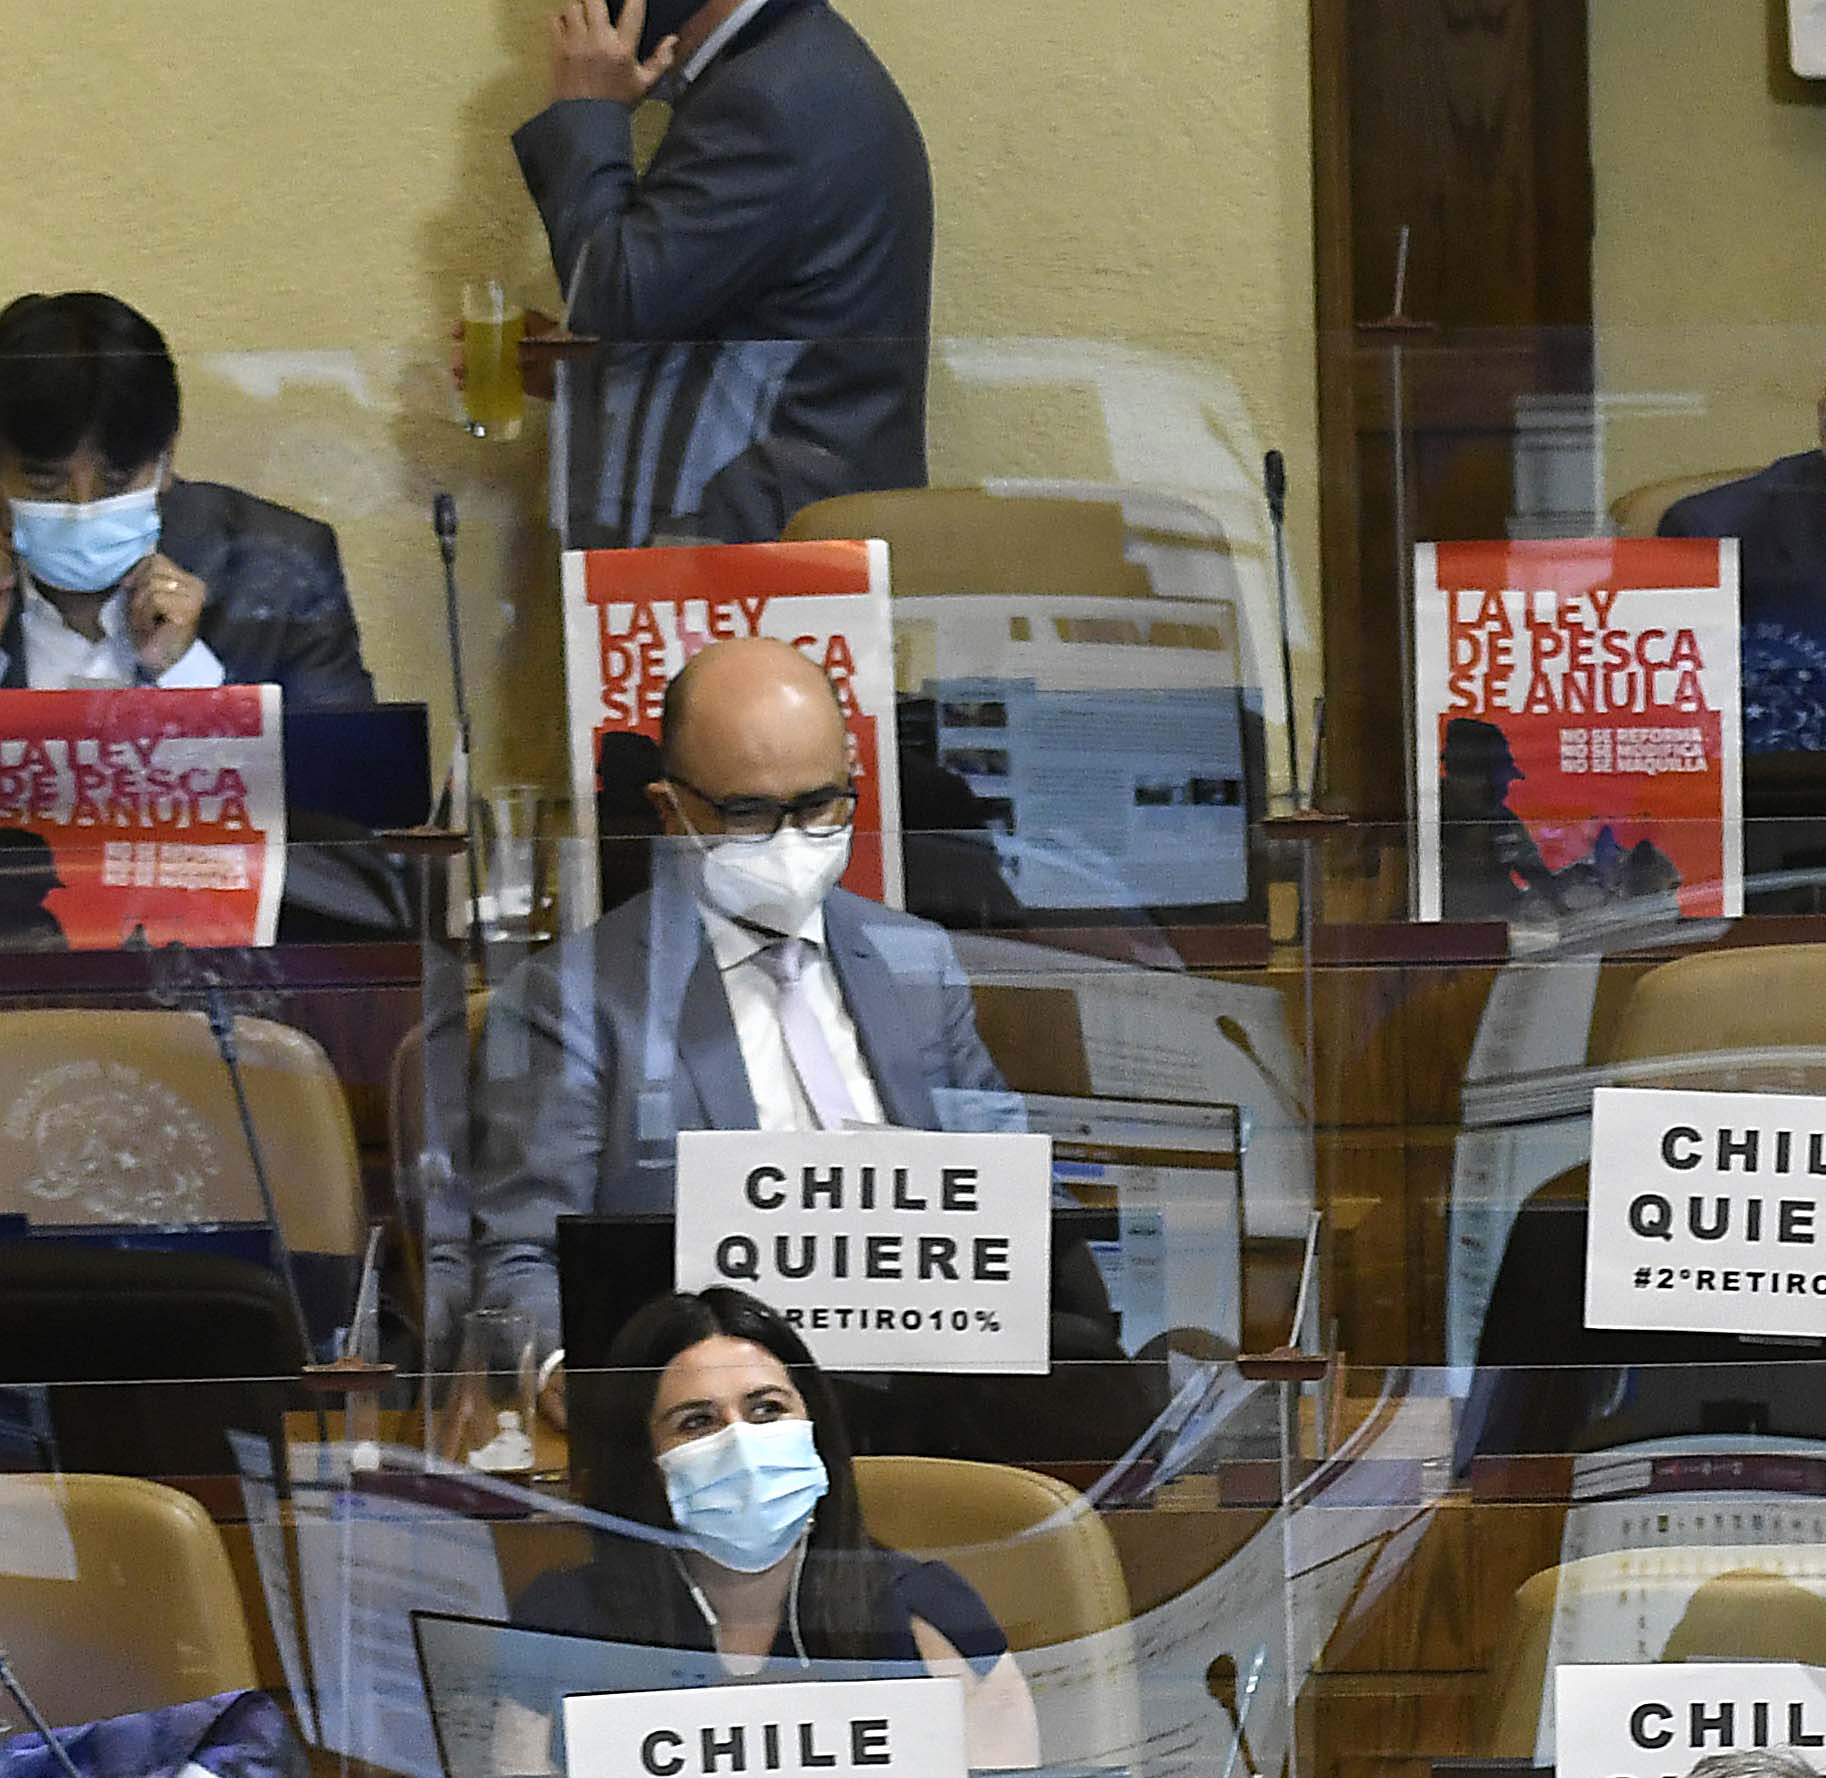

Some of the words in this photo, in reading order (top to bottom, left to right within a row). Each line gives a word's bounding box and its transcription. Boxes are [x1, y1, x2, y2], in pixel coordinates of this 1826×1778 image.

[598, 599, 665, 648] LA
[676, 597, 769, 643] LEY
[1447, 589, 1513, 634] LA
[1525, 588, 1617, 629] LEY
[601, 640, 667, 684] DE
[1448, 629, 1514, 671] DE
[1531, 628, 1703, 672] PESCA
[600, 683, 664, 724] SE
[1448, 671, 1511, 712] SE
[1526, 670, 1708, 713] ANULA
[78, 768, 247, 797] PESCA
[746, 1167, 977, 1211] CHILE
[716, 1236, 1010, 1281] QUIERE
[642, 1720, 890, 1776] CHILE
